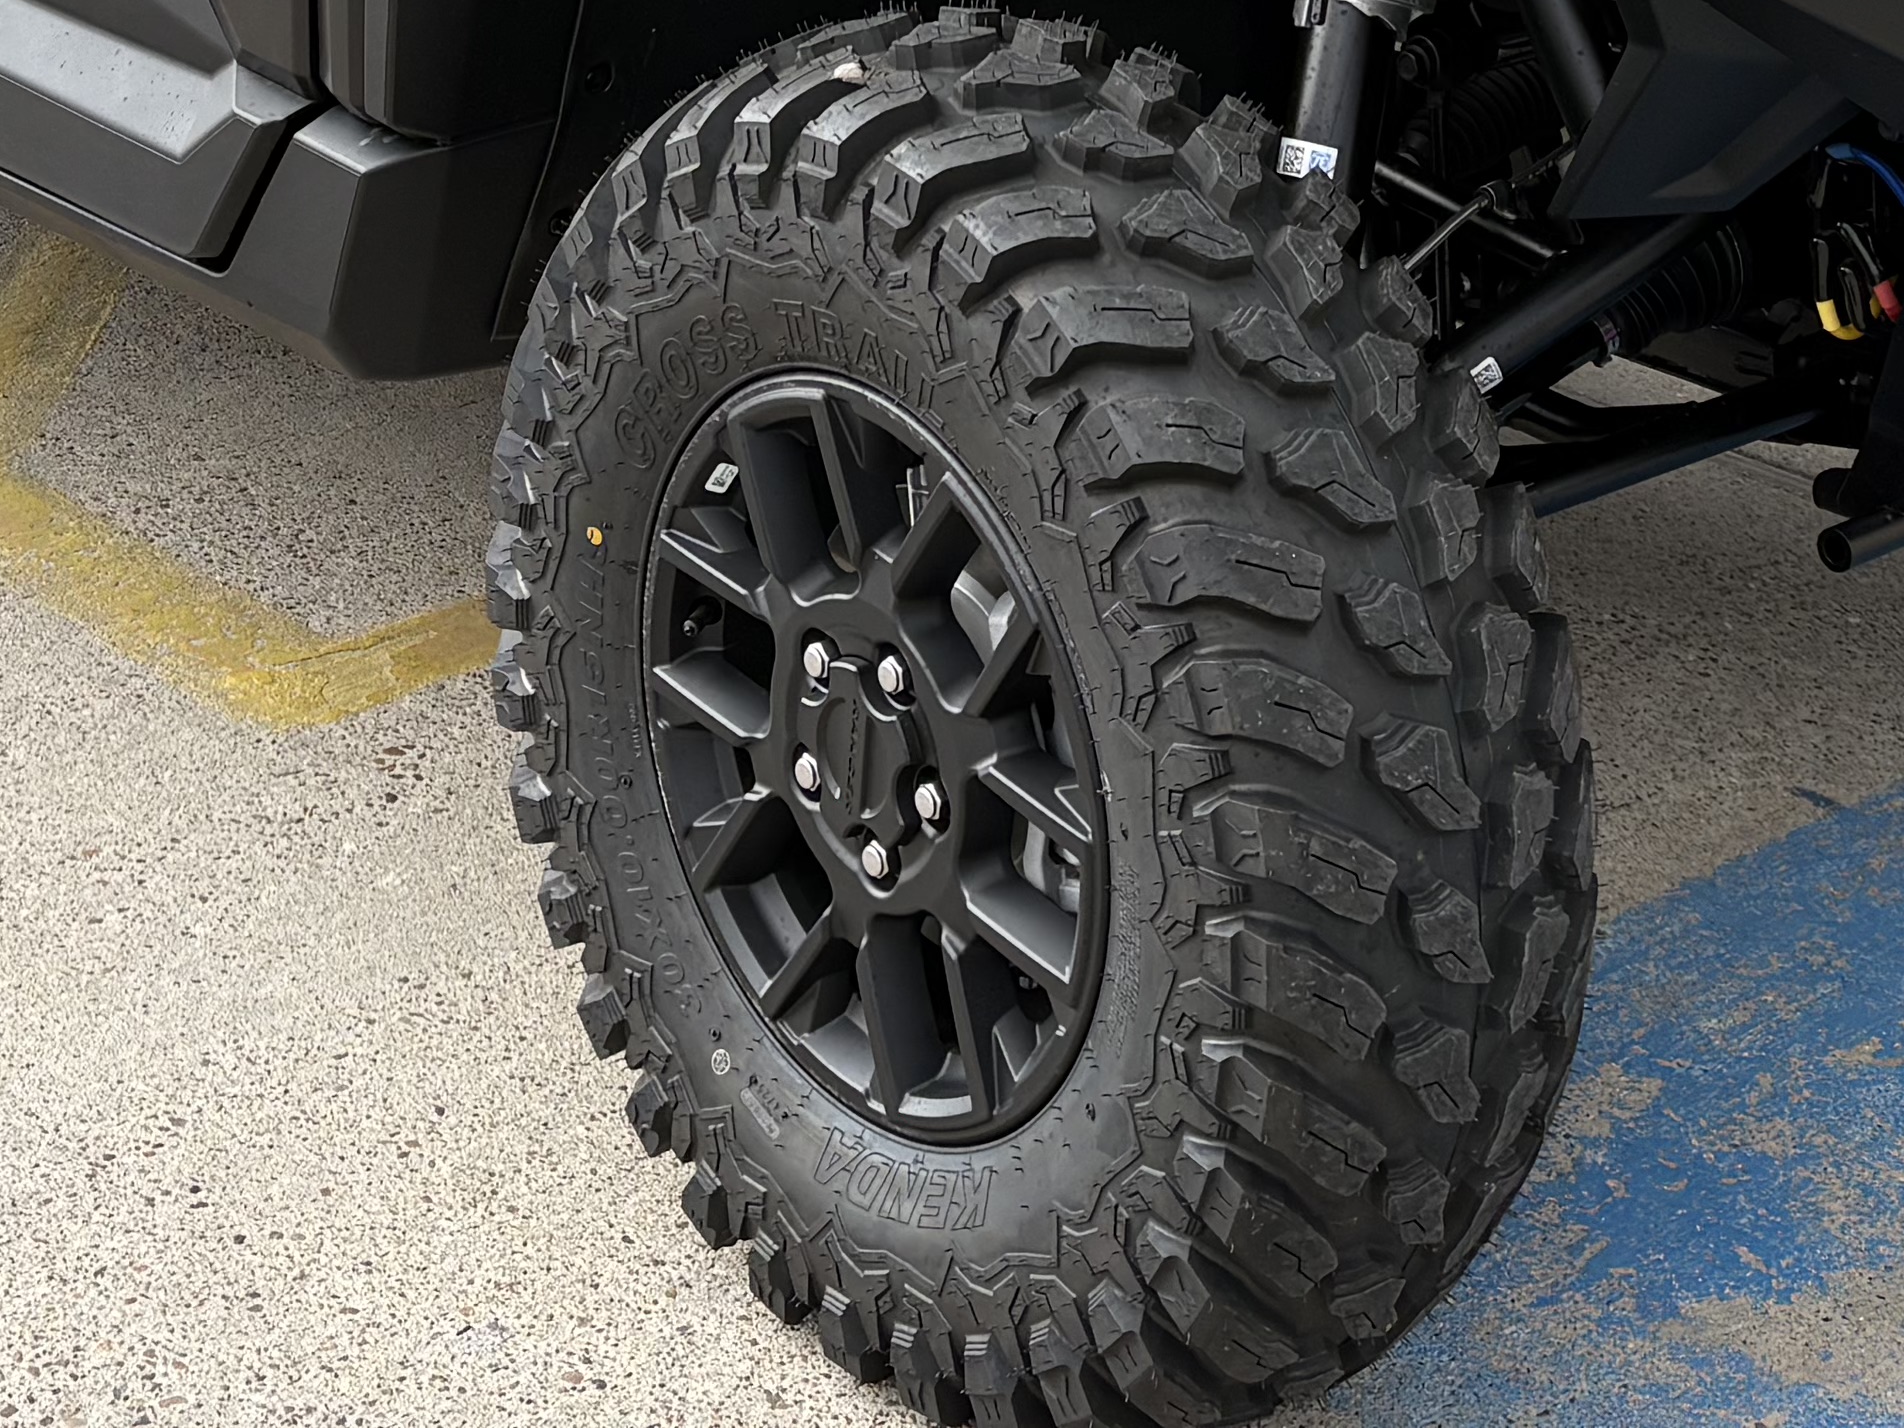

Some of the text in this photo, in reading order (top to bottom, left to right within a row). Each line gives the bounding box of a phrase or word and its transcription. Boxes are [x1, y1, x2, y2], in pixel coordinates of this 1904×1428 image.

[614, 298, 943, 469] CROSS TRAIL
[813, 1125, 993, 1232] KENDA
